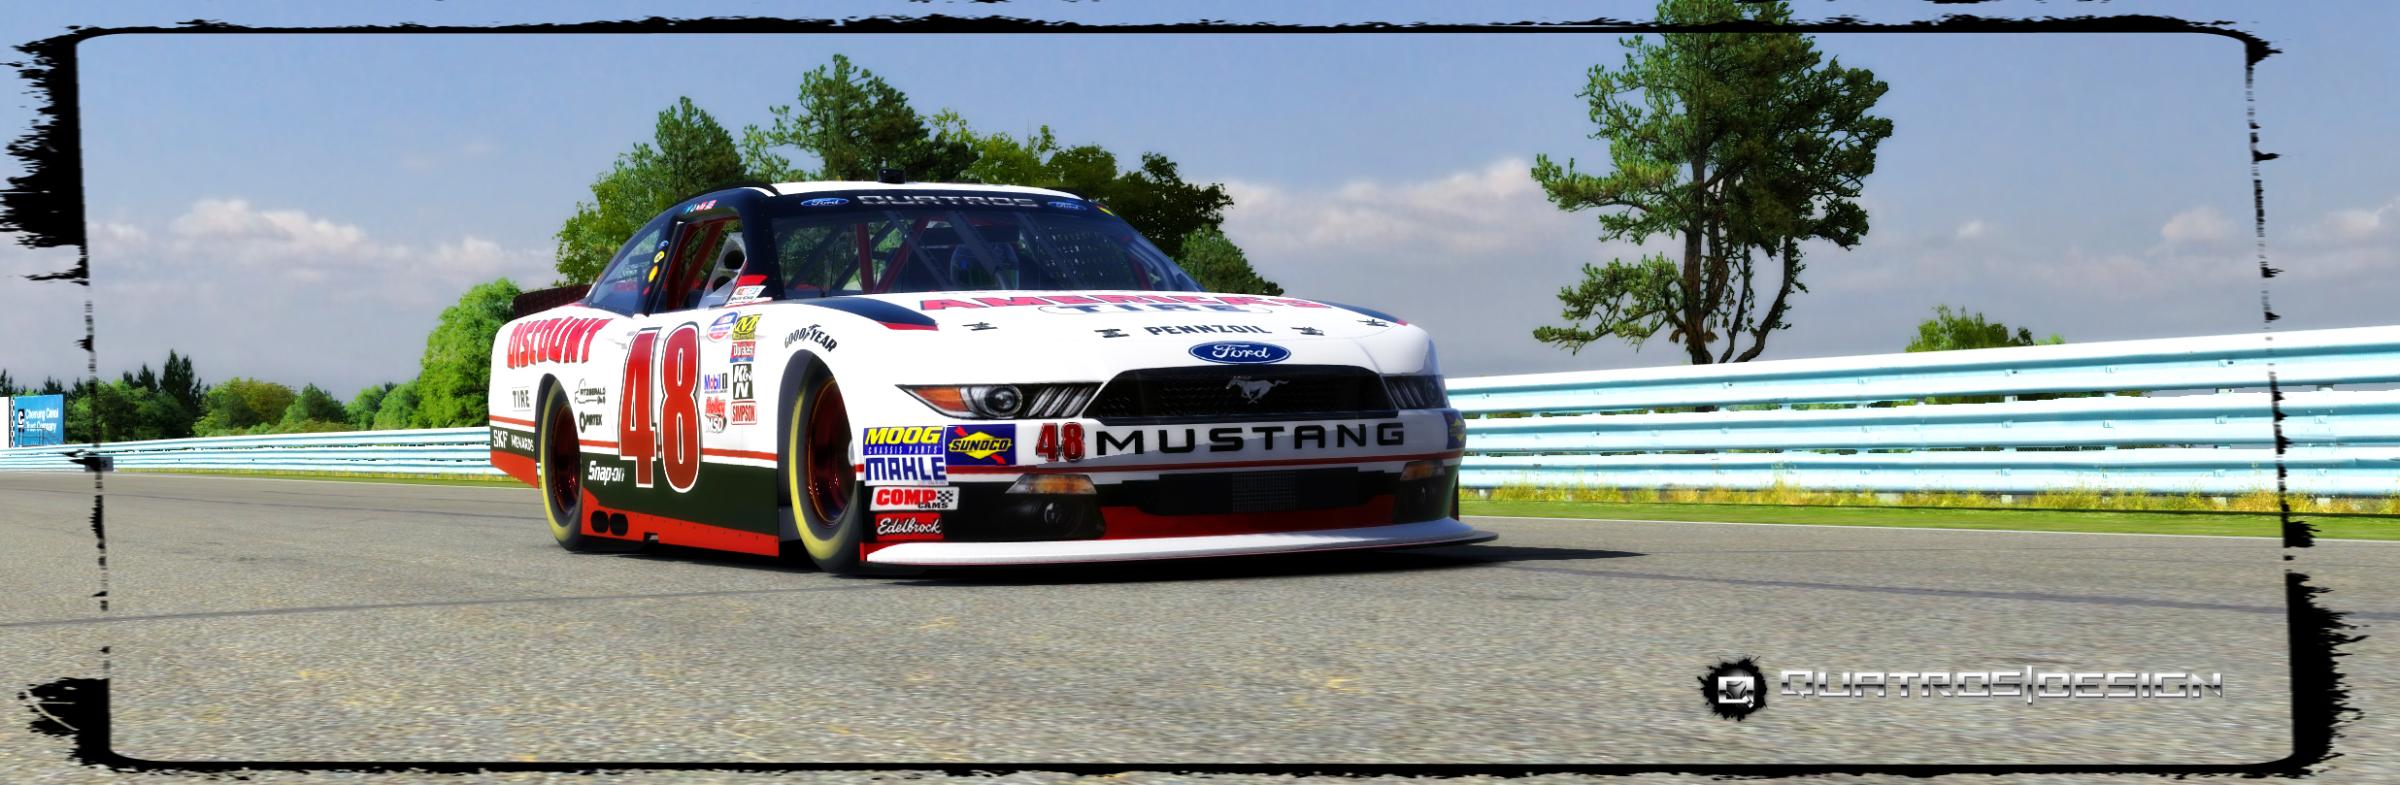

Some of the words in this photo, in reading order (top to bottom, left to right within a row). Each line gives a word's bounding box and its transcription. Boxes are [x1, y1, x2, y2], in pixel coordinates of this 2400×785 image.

[810, 197, 840, 207] Ford
[856, 195, 1039, 208] QUATROS
[1056, 303, 1252, 313] TIRE
[785, 324, 838, 352] GOODYEAR
[1143, 324, 1273, 336] PENNZOIL
[507, 316, 614, 369] DISCOUNT
[1211, 343, 1271, 359] Ford
[704, 374, 721, 390] Mobil
[512, 389, 530, 408] TIRE
[618, 321, 702, 493] 48
[732, 404, 756, 422] SIMPSON
[493, 429, 508, 448] SKF
[865, 427, 943, 445] MOOG
[1036, 422, 1086, 462] 48
[1096, 422, 1405, 456] MUSTANG
[868, 446, 903, 454] CHASSIS
[908, 445, 938, 454] PARTS
[950, 440, 1010, 451] SUNOCO
[587, 460, 625, 485] Snap-on
[865, 457, 947, 480] MAHLE
[876, 489, 936, 505] COMP
[876, 518, 942, 535] Edelbrock
